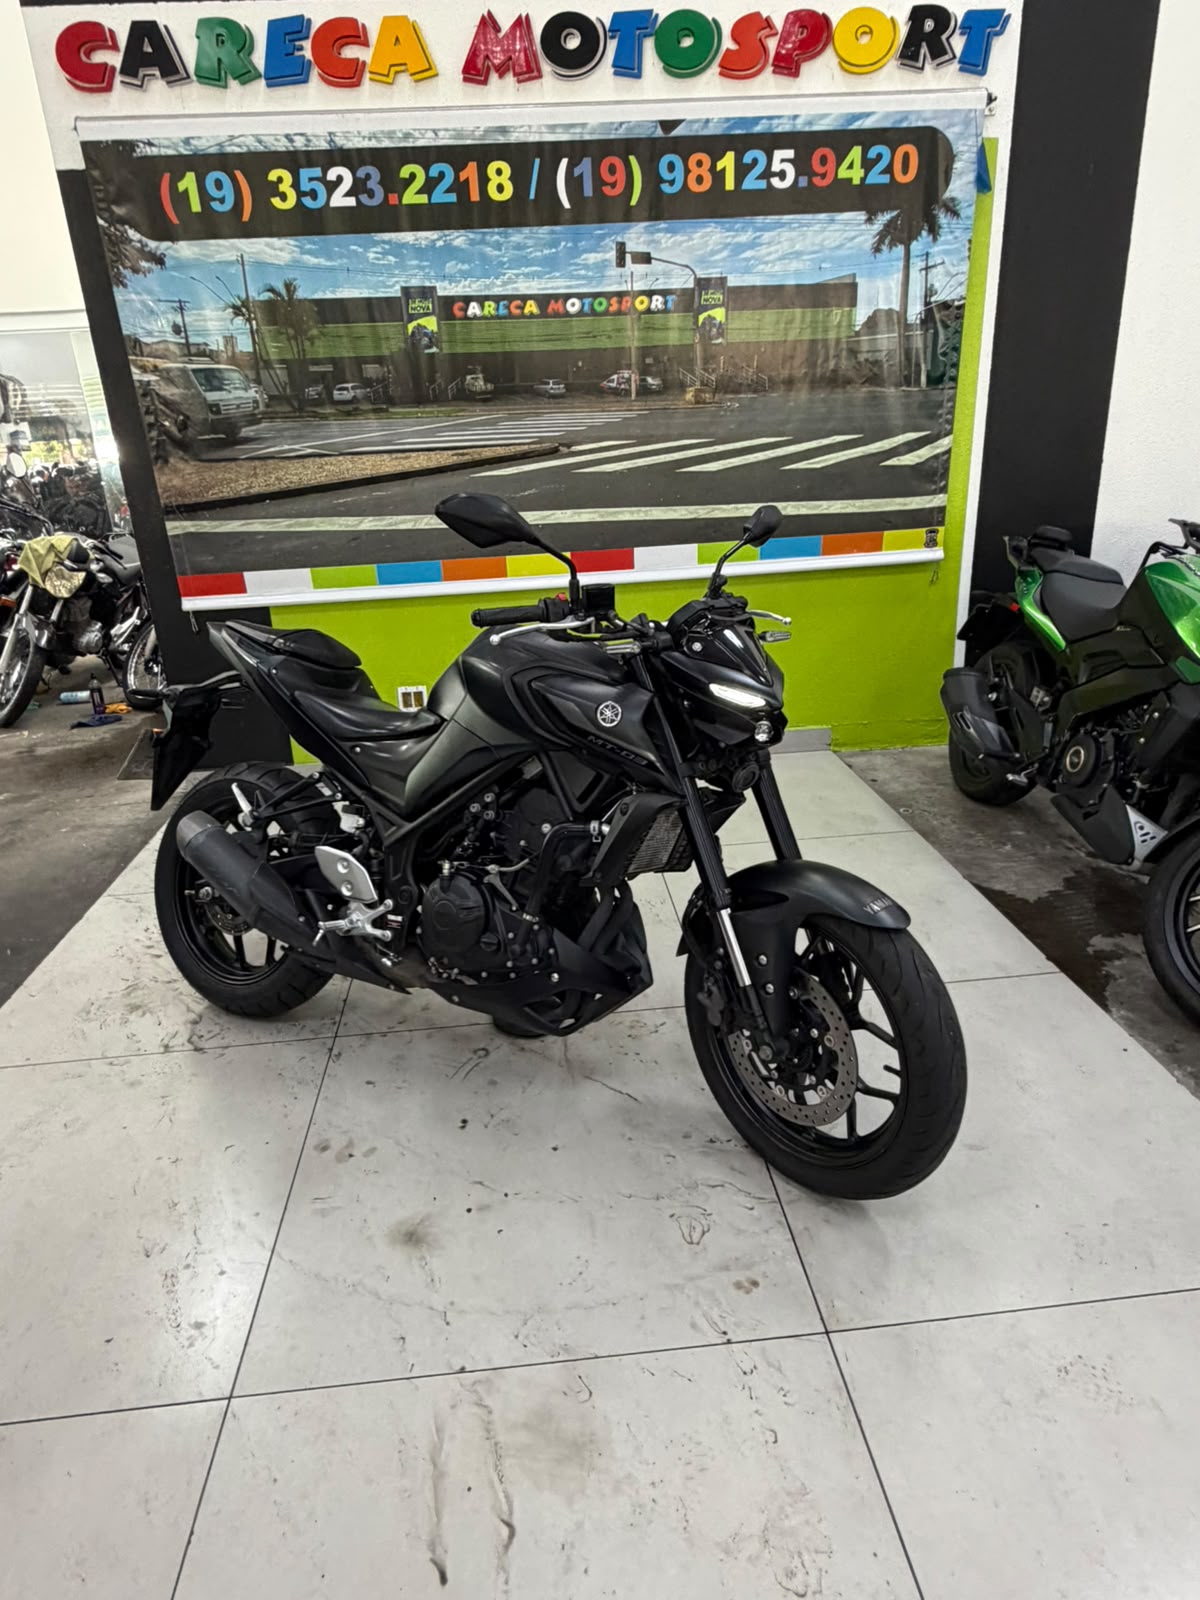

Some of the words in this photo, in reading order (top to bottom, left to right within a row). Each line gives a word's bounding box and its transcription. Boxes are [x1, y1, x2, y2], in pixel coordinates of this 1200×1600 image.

[55, 15, 439, 93] CARECA
[462, 5, 1011, 86] MOTOSPORT
[159, 171, 253, 225] (19)
[266, 160, 514, 211] 3523.2218
[556, 154, 642, 209] (19)
[658, 143, 919, 195] 98125.9420
[452, 299, 540, 318] CARECA
[547, 294, 678, 315] MOTOSPORT
[586, 735, 649, 766] MT-03
